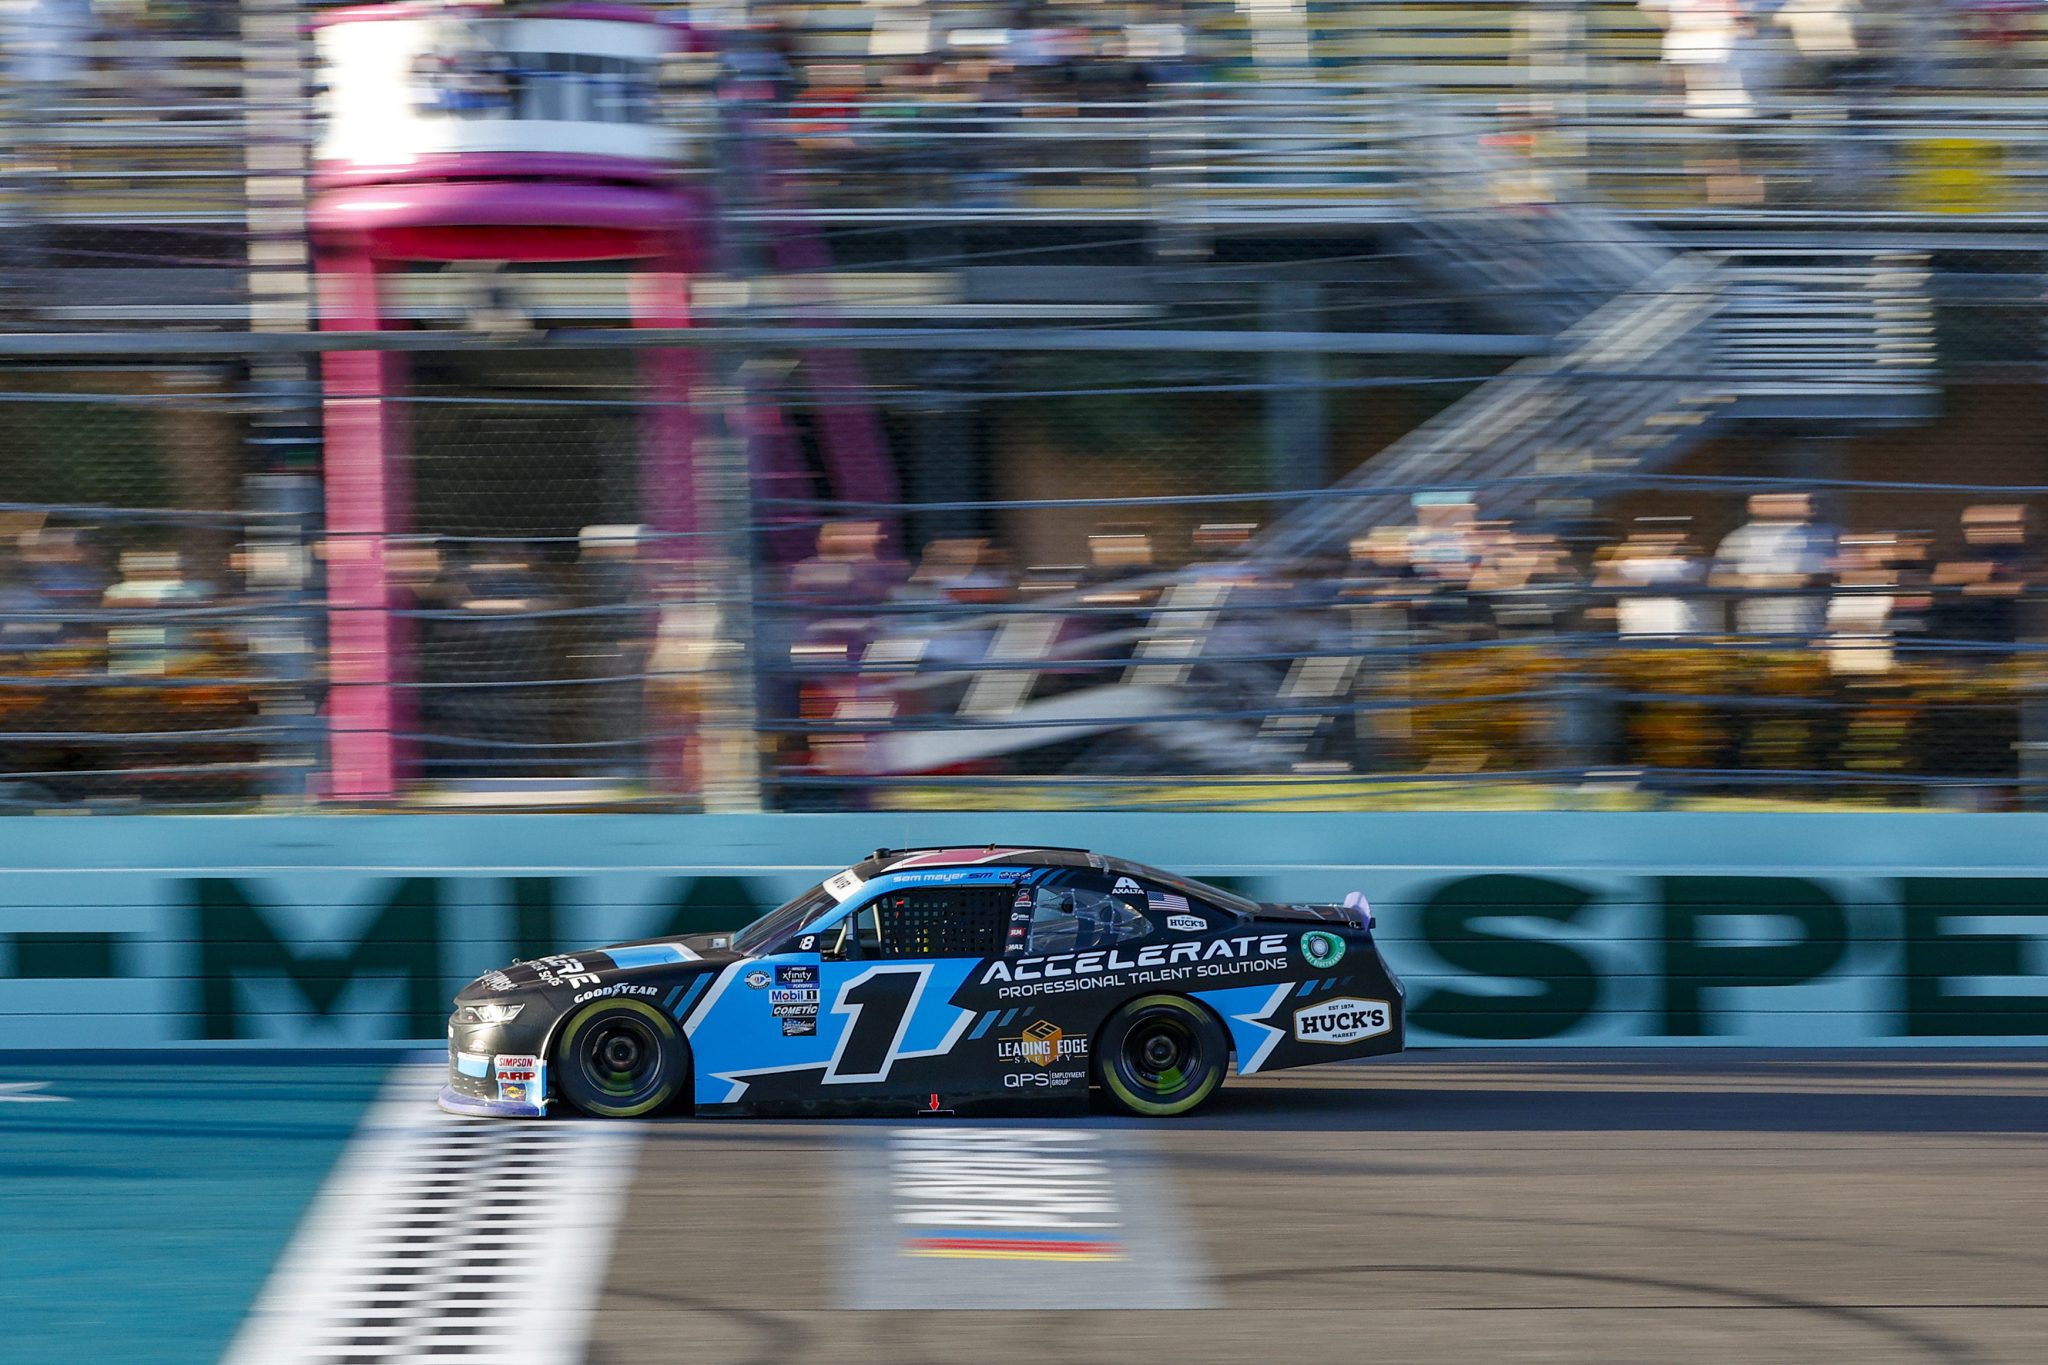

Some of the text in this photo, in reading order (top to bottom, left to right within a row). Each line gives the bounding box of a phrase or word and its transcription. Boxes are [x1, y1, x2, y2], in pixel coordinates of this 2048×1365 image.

[1169, 919, 1205, 928] HUCK'S
[980, 933, 1289, 985] ACCELERATE
[782, 970, 812, 981] xfinity
[999, 957, 1288, 1000] PROFESSIONAL TALENT SOLUTIONS
[574, 983, 658, 1004] GOODYEAR
[771, 990, 803, 1000] Mobil
[773, 1004, 818, 1015] COMETIC
[1301, 1009, 1385, 1034] HUCK'S
[1332, 1031, 1357, 1039] MARKET
[998, 1038, 1088, 1057] LEADING EDGE
[499, 1057, 533, 1068] SIMPSON
[497, 1071, 537, 1080] ARP
[1004, 1073, 1050, 1088] QPS
[1051, 1071, 1086, 1079] EMPLOYMENT
